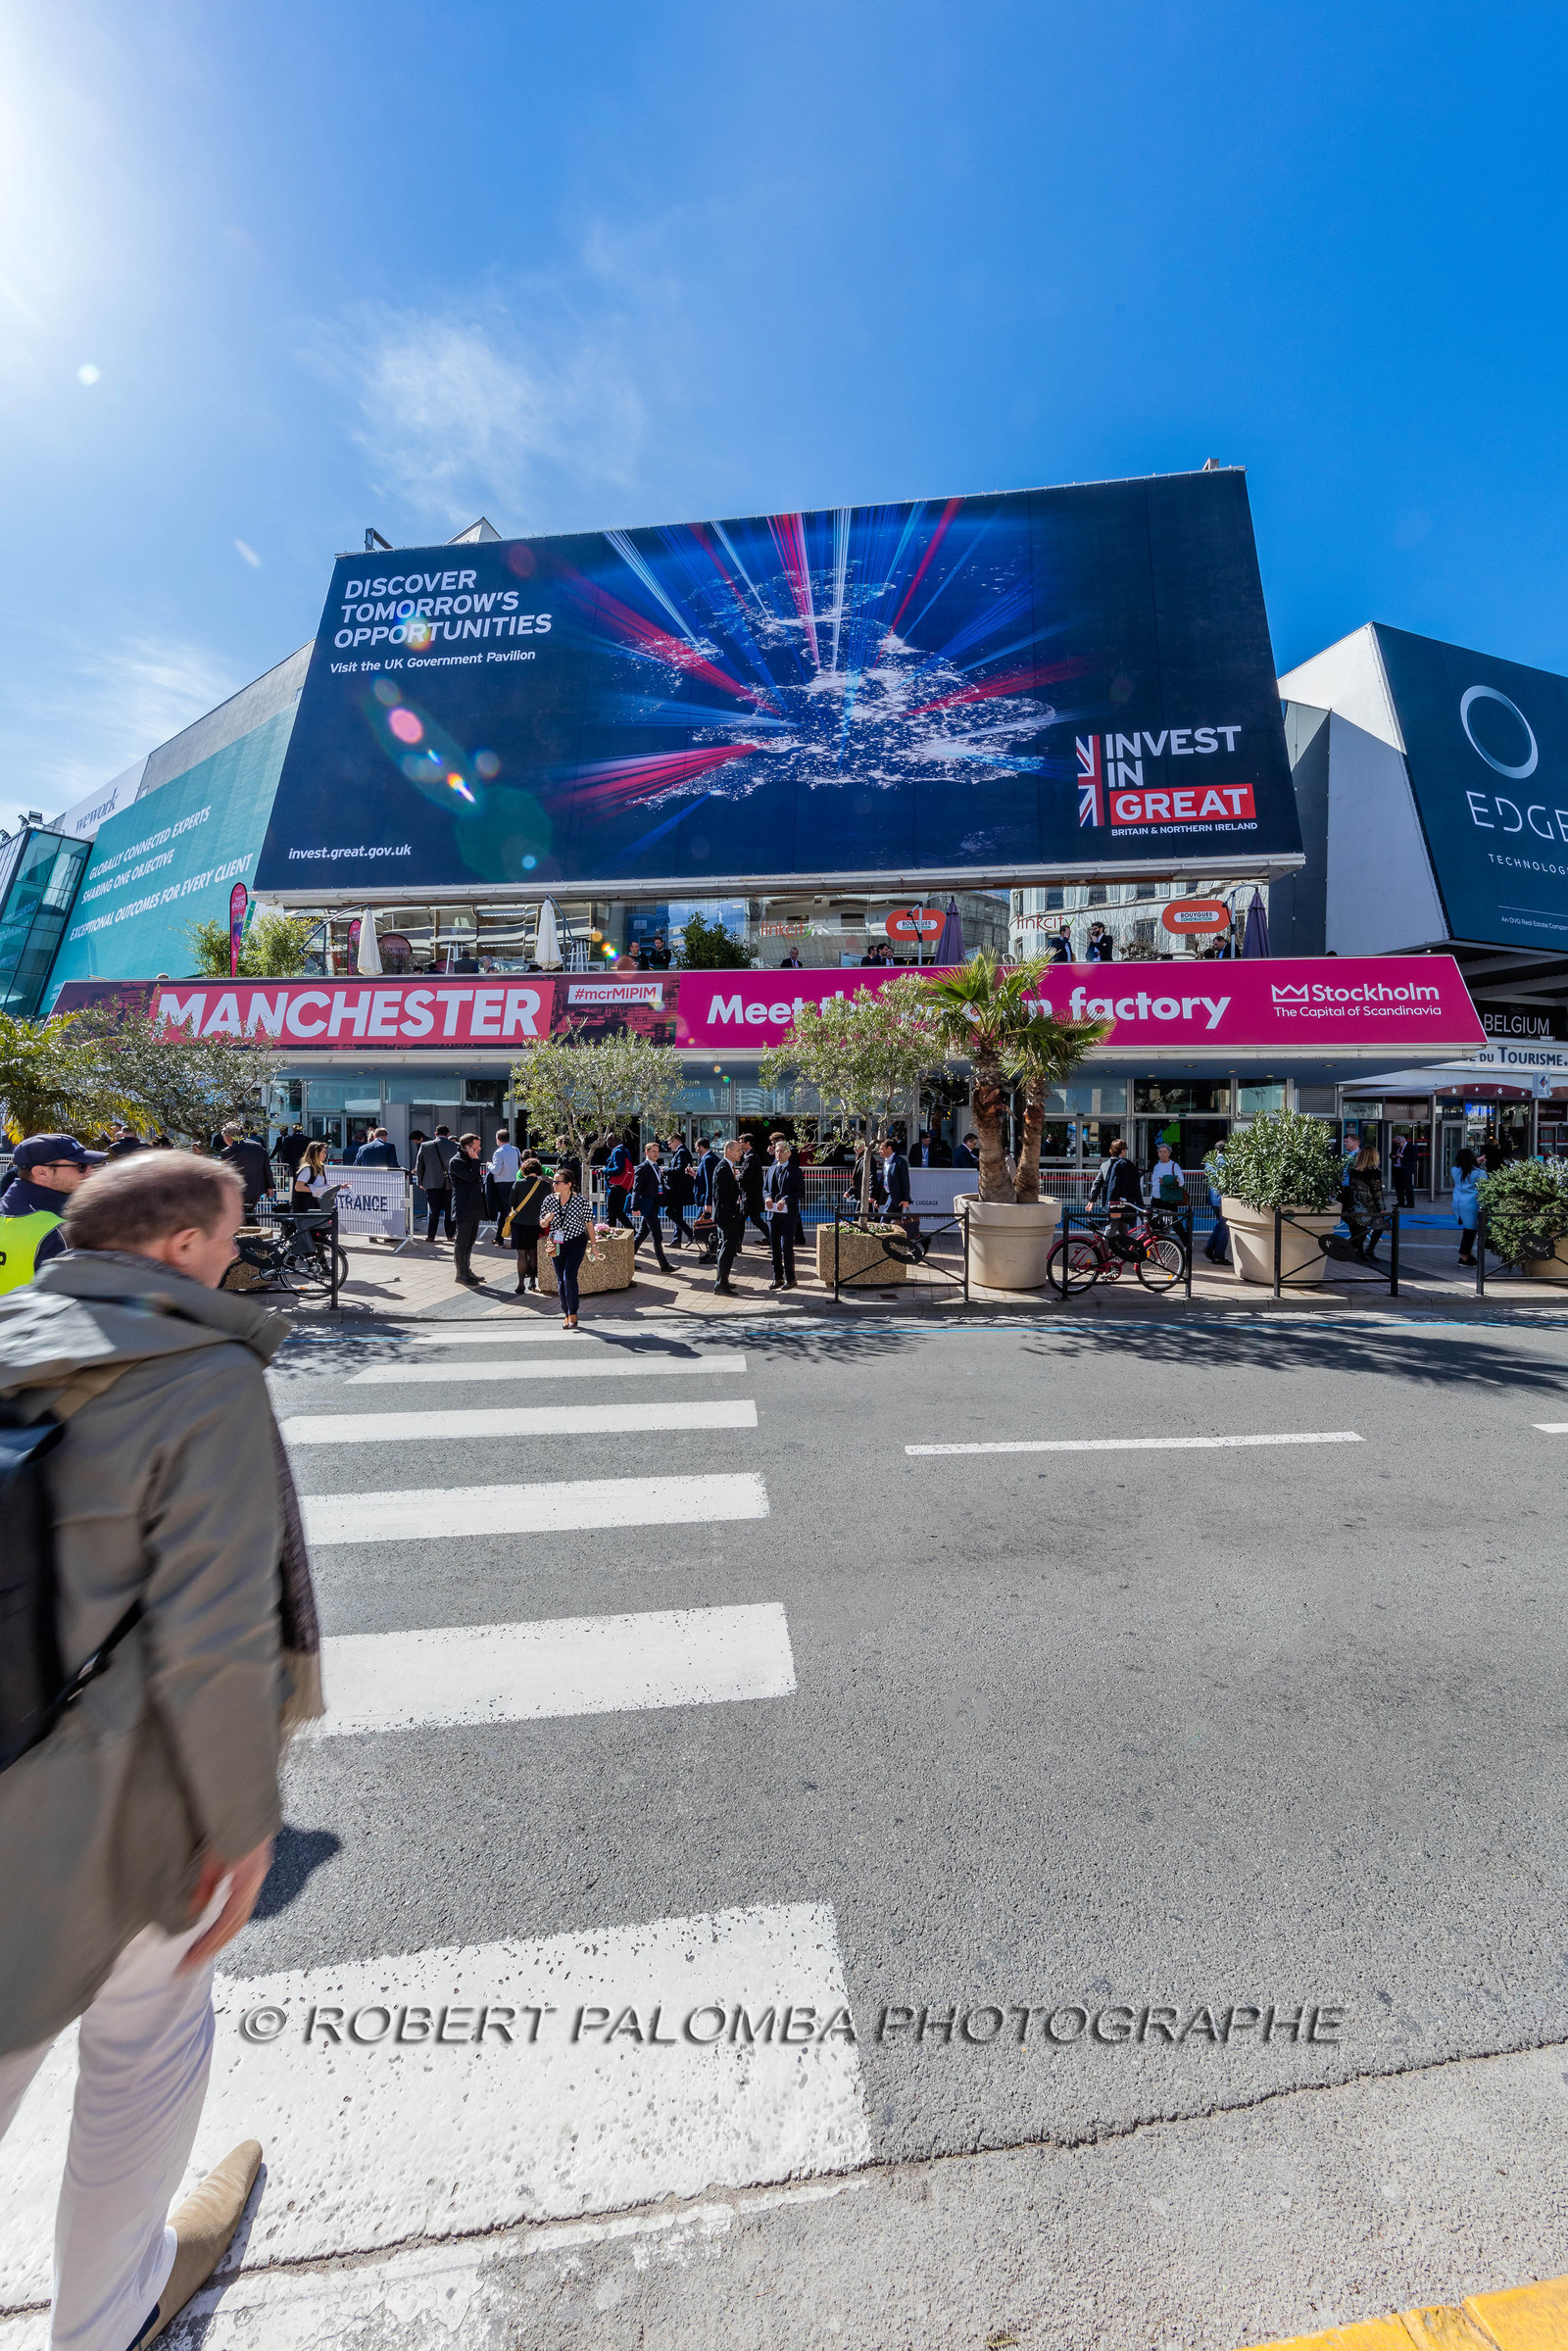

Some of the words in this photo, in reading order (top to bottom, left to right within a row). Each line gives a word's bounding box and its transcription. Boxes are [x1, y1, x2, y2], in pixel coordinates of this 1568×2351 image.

[344, 569, 477, 599] DISCOVER
[341, 591, 519, 623] TOMORROW'S
[334, 613, 553, 648] OPPORTUNITIES
[329, 661, 358, 674] Visit
[361, 660, 381, 671] the
[384, 658, 405, 669] UK
[407, 653, 483, 668] Government
[486, 650, 536, 663] Pavilion
[1105, 725, 1243, 759] INVEST
[1106, 760, 1144, 788] IN
[75, 787, 120, 834] wework
[1115, 788, 1249, 820] GREAT
[1111, 827, 1149, 836] BRITAIN
[1159, 824, 1213, 834] NORTHERN
[1214, 822, 1258, 832] IRELAND
[89, 852, 123, 881] GLOBALLY
[122, 828, 172, 862] CONNECTED
[172, 806, 212, 838] EXPERTS
[288, 844, 412, 859] invest.great.gov.uk
[81, 878, 114, 905] SHARING
[114, 872, 131, 889] ONE
[131, 849, 175, 881] OBJECTIVE
[1488, 854, 1568, 875] TECHNOLOG
[69, 911, 116, 942] EXCEPTIONAL
[115, 896, 159, 923] OUTCOMES
[159, 887, 179, 905] FOR
[180, 869, 215, 897] EVERY
[214, 853, 254, 883] CLIENT
[761, 921, 814, 940] linkcity
[1016, 914, 1075, 932] linkcity
[574, 987, 657, 1001] #mcrMIPIM
[1312, 983, 1440, 1003] Stockholm
[152, 990, 541, 1039] MANCHESTER
[1069, 986, 1232, 1029] factory
[1274, 1006, 1297, 1017] The
[1299, 1005, 1346, 1018] Capital
[1348, 1005, 1360, 1016] of
[1363, 1004, 1442, 1016] Scandinavia
[1484, 1013, 1550, 1035] BELGIUM
[1479, 1053, 1494, 1062] DU
[1496, 1046, 1563, 1066] TOURISME
[335, 1195, 388, 1211] TRANCE
